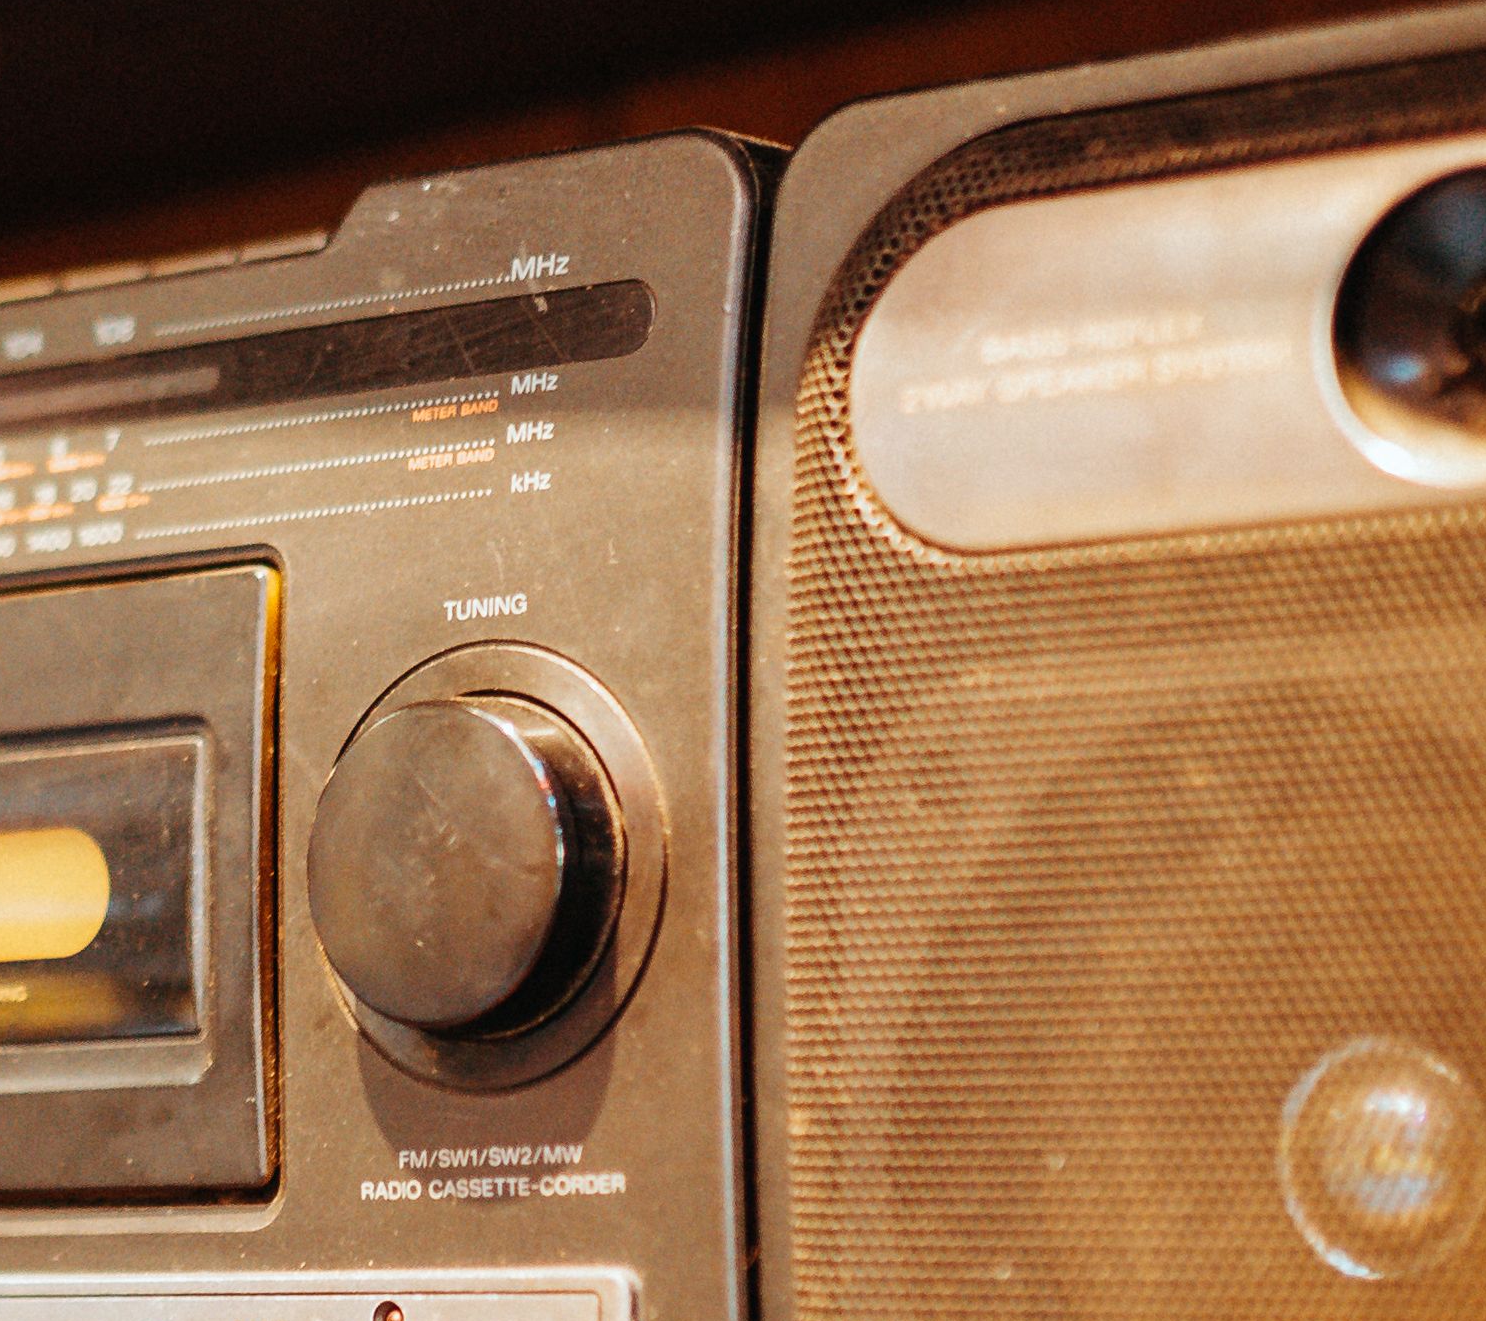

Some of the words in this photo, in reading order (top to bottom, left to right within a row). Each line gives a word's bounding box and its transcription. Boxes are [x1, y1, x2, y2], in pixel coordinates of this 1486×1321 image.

[510, 254, 570, 282] MHz
[511, 373, 559, 395] MHz
[412, 404, 457, 422] METER
[461, 399, 499, 417] BAND
[507, 421, 555, 444] MHz
[408, 452, 453, 471] METER
[456, 447, 495, 465] BAND
[510, 471, 551, 493] kHz
[443, 592, 527, 621] TUNING
[398, 1145, 583, 1169] FM/SW1/SW2/MW
[360, 1179, 422, 1200] RADIO
[428, 1172, 626, 1199] CASSETTE-CORDER
